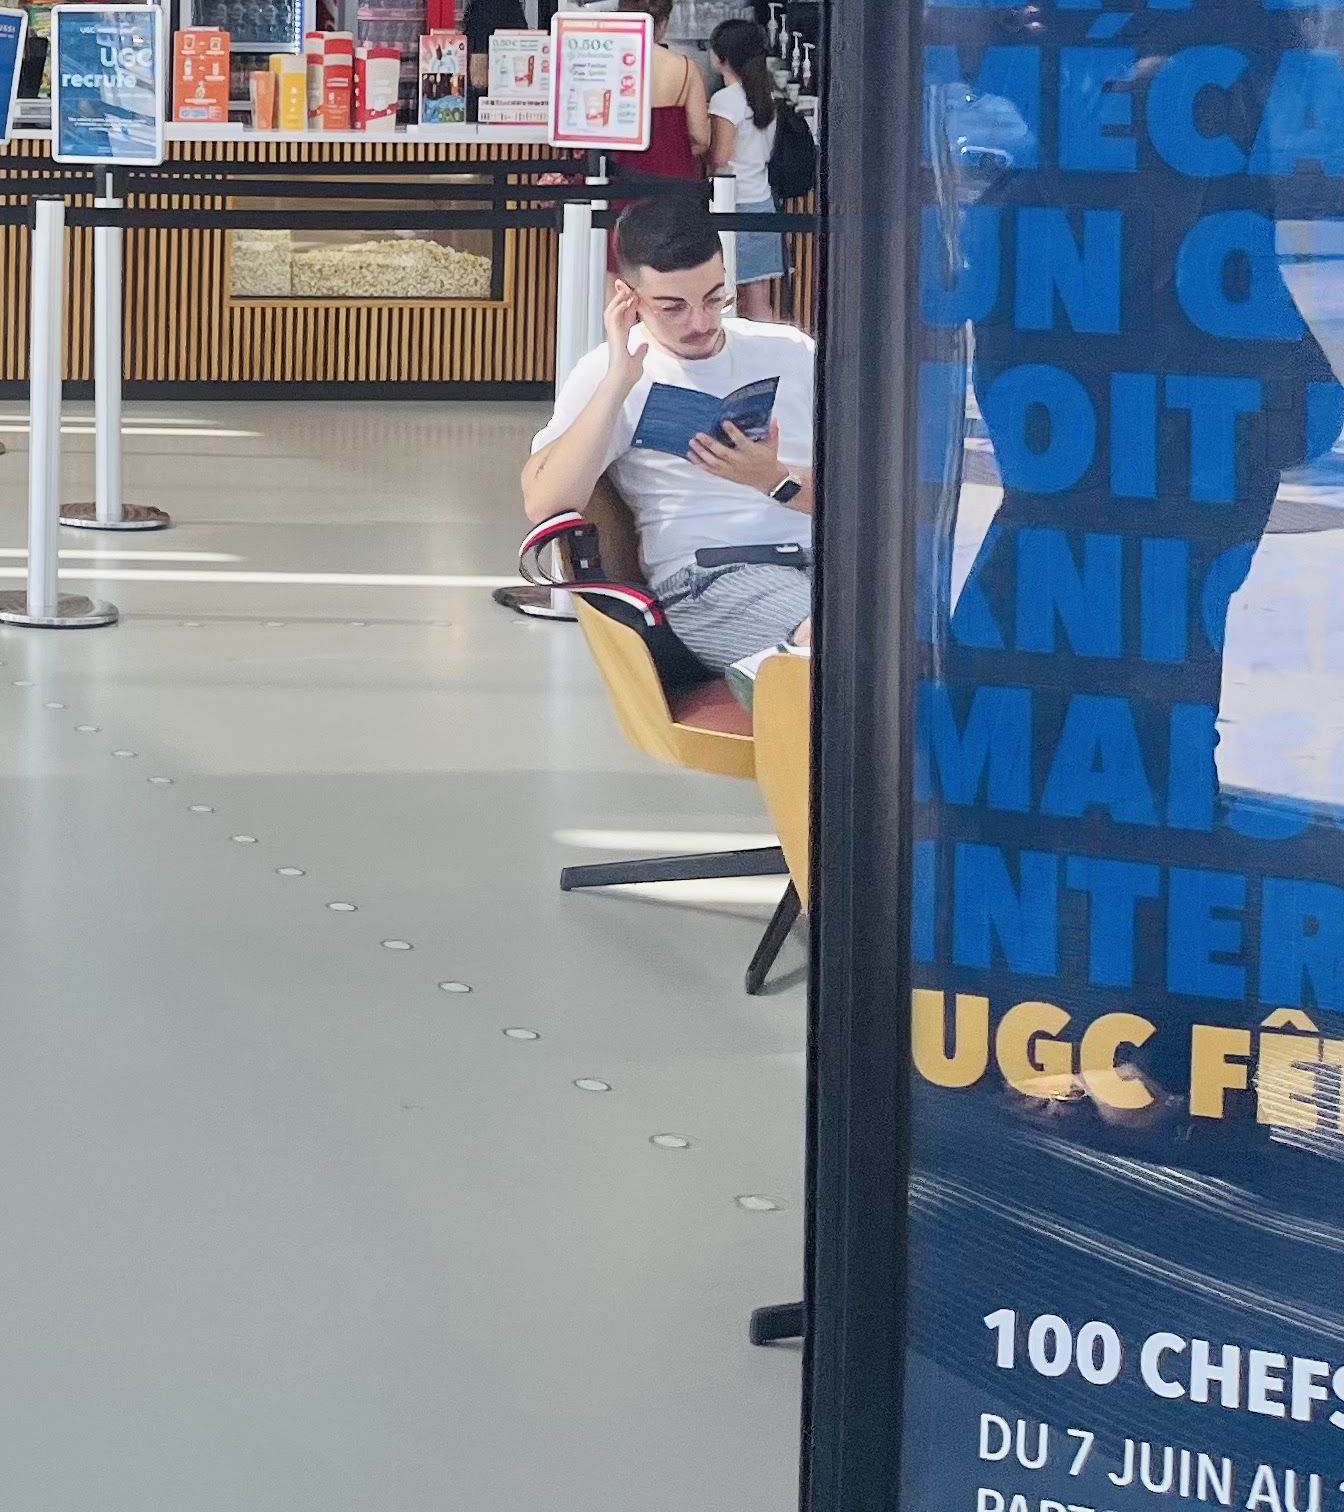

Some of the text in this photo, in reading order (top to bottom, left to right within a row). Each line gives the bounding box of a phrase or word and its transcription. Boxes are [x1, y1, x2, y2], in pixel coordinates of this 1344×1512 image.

[62, 73, 138, 88] recrute
[100, 47, 153, 68] UGC
[912, 988, 1344, 1133] UGC FÊ
[983, 1308, 1123, 1386] 100
[979, 1412, 1049, 1469] DU
[1067, 1428, 1095, 1476] 7
[1108, 1438, 1232, 1506] JUIN
[1245, 1463, 1323, 1512] AU
